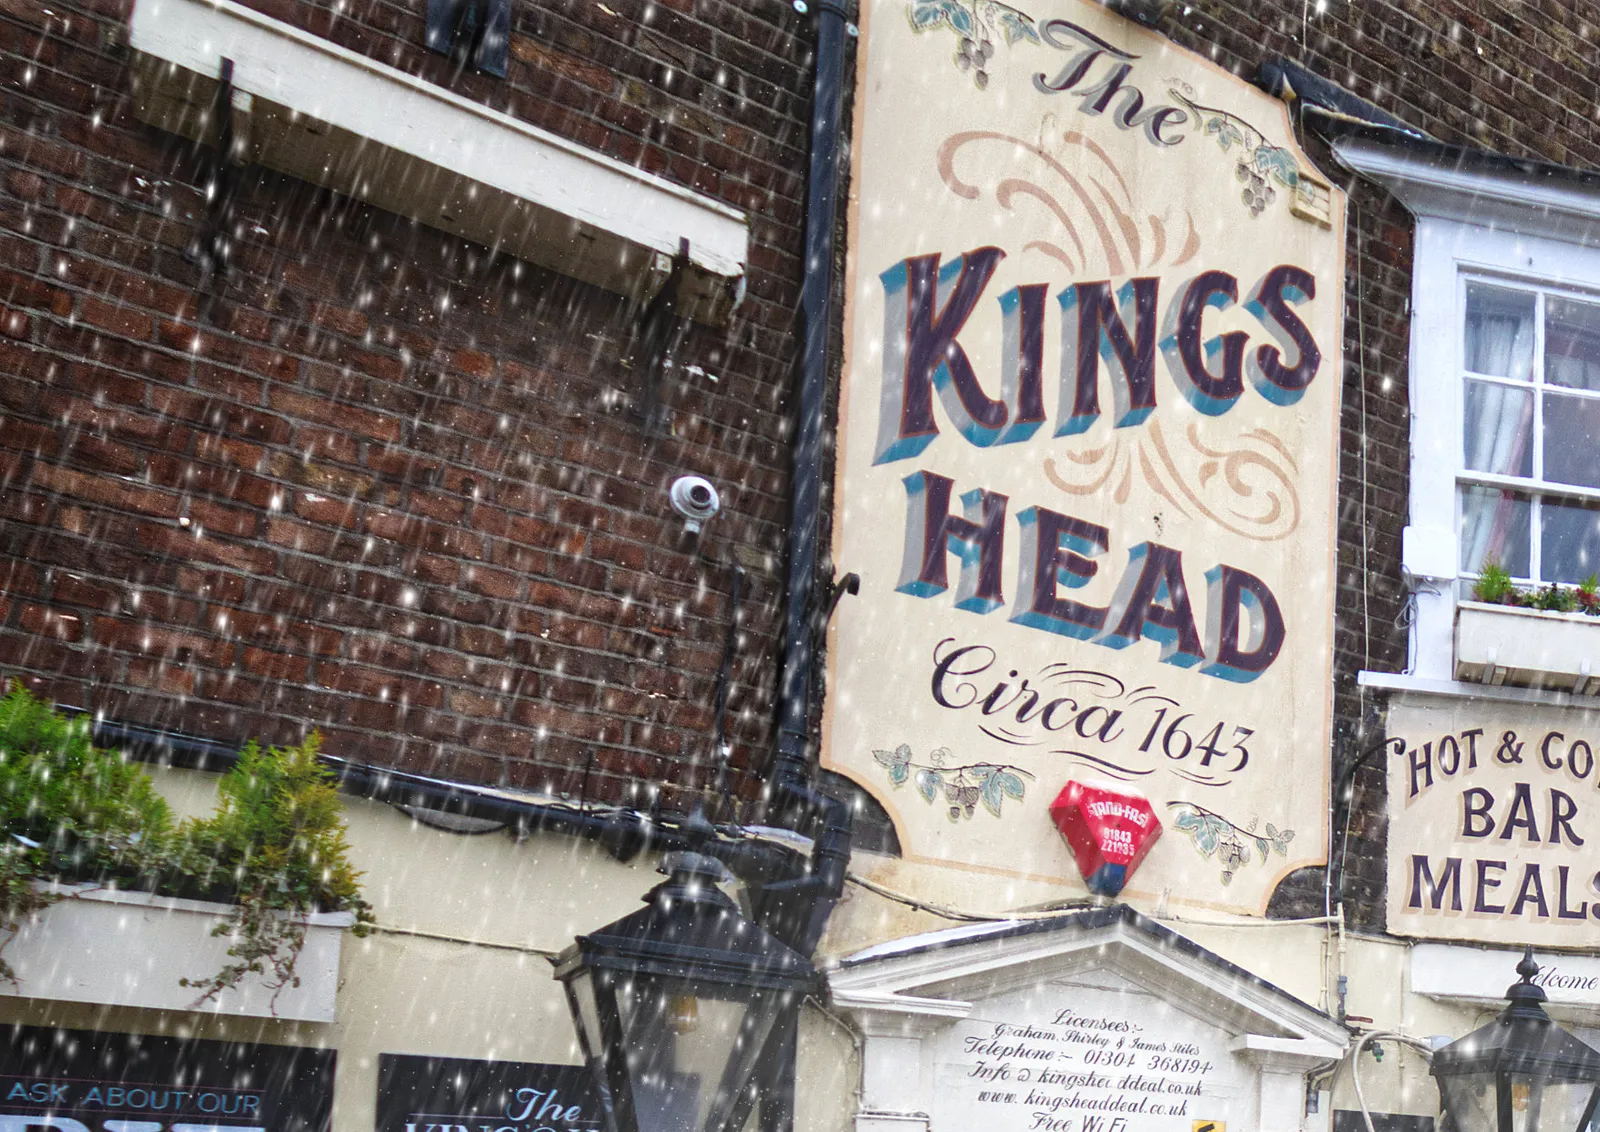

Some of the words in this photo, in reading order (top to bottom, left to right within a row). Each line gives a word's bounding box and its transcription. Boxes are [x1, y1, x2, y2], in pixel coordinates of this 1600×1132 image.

[1033, 18, 1189, 147] The
[871, 245, 1321, 466] KINGS
[895, 470, 1286, 683] HEAD
[931, 637, 1124, 744] Circa
[1138, 707, 1256, 774] 1643
[1408, 728, 1484, 798] HOT
[1496, 730, 1525, 764] &
[1462, 782, 1585, 846] BAR
[1517, 966, 1599, 990] elcome
[1062, 1029, 1111, 1047] Shirley
[1116, 1037, 1125, 1049] &
[1129, 1038, 1166, 1052] James
[1083, 1049, 1135, 1068] 01304
[1147, 1055, 1214, 1075] 368194
[968, 1060, 1010, 1083] Info
[7, 1082, 70, 1104] ASK
[82, 1086, 189, 1110] ABOUT
[198, 1092, 260, 1113] OUR
[506, 1087, 581, 1122] The
